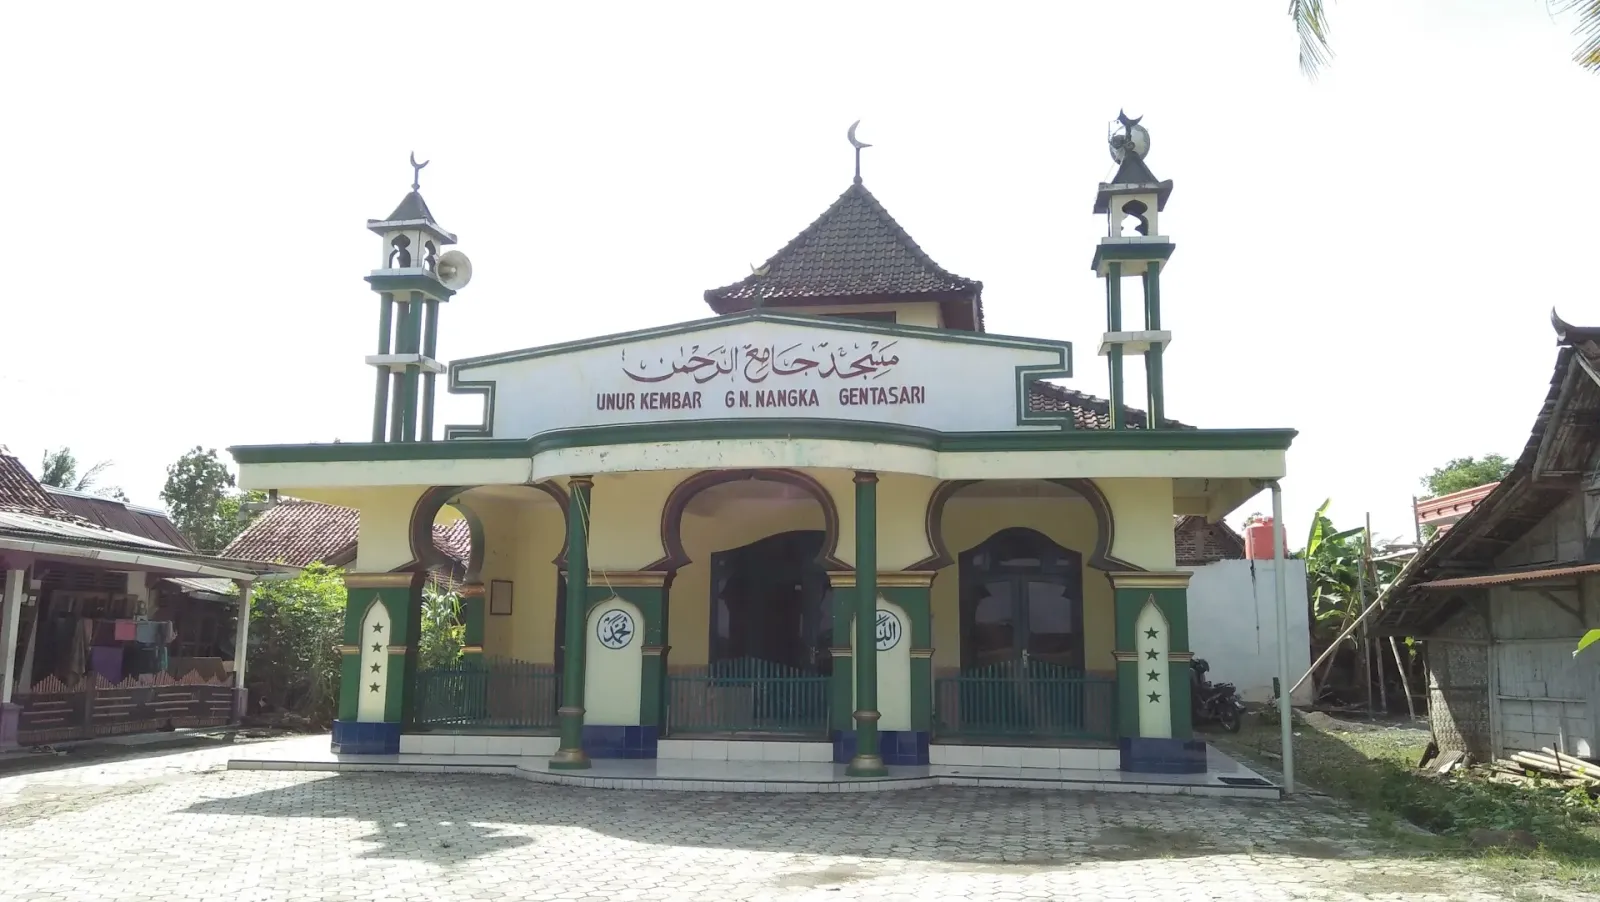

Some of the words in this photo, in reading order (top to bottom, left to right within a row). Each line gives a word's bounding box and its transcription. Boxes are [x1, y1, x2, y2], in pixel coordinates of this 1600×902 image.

[596, 392, 636, 411] UNUR
[640, 390, 702, 410] KEMBAR
[838, 386, 925, 406] GENTASARI
